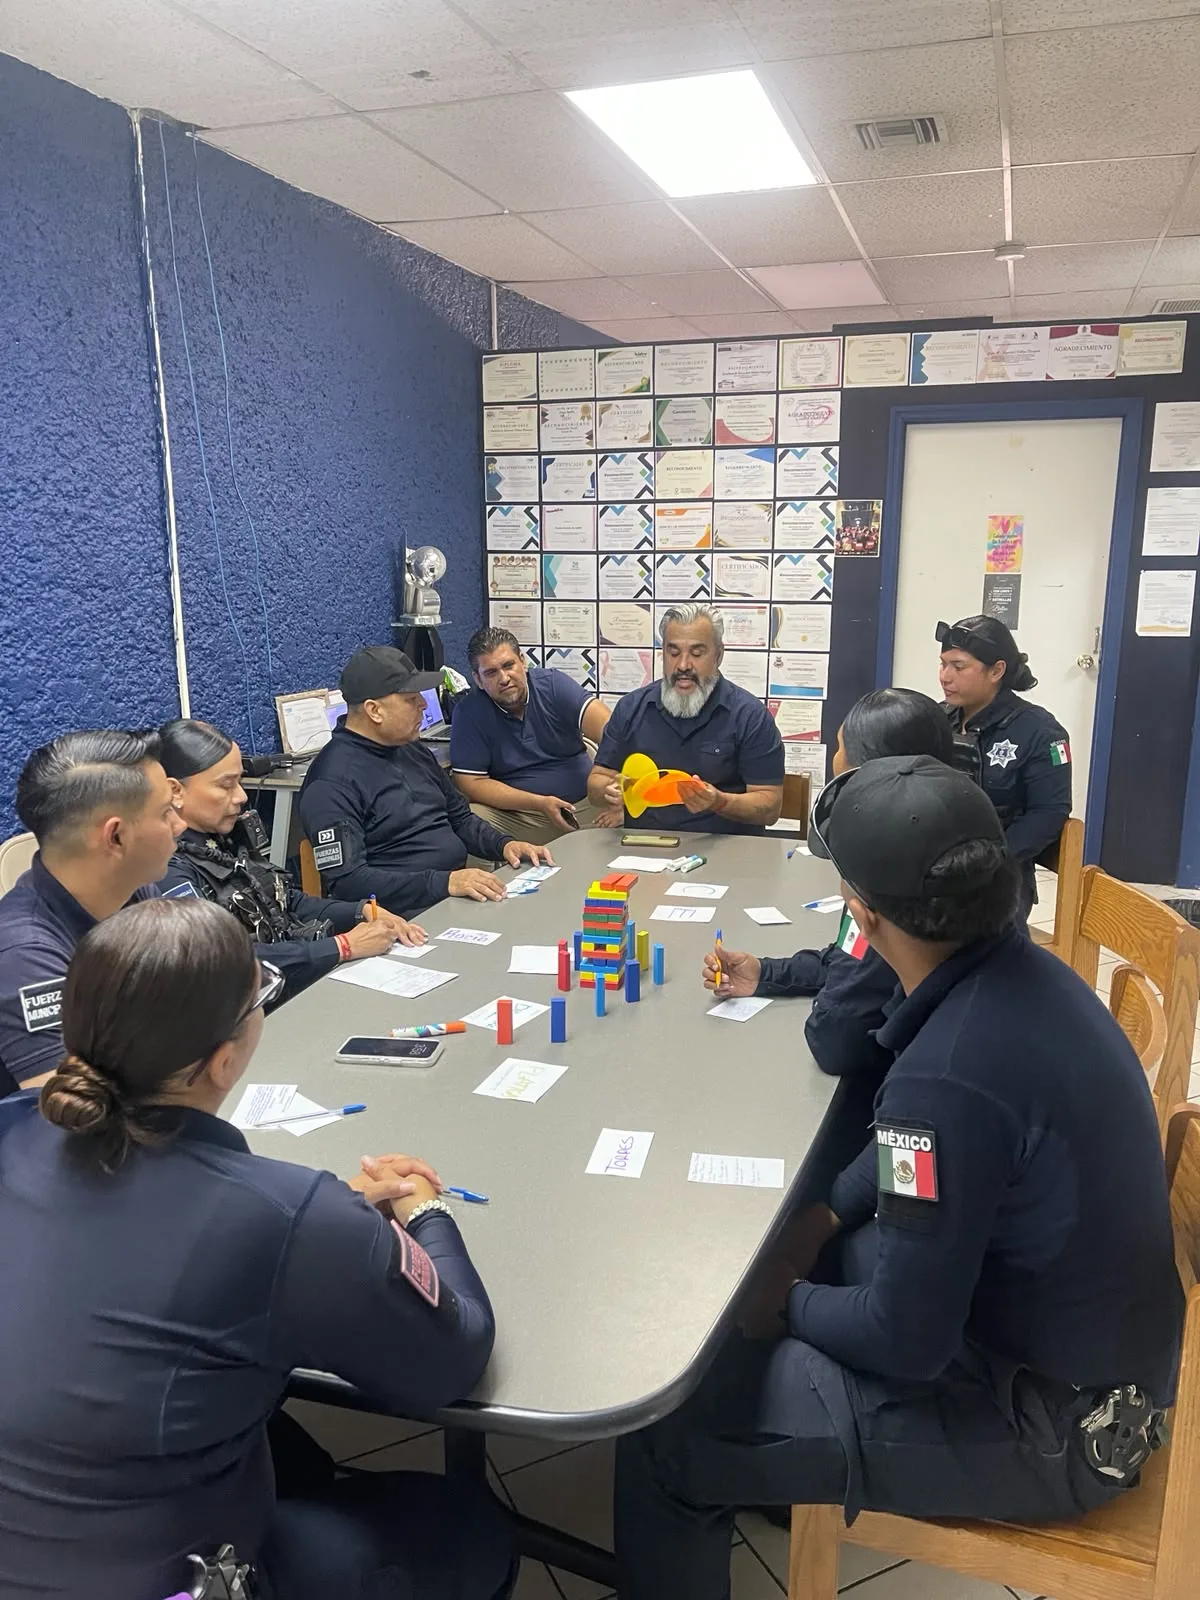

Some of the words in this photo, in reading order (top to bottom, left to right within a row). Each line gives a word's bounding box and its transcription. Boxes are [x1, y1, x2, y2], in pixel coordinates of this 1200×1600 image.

[1054, 344, 1112, 352] AGRADECIMIENTO
[24, 990, 63, 1009] FUERZ
[877, 1129, 932, 1152] MÉXICO
[604, 1136, 634, 1173] TORRES
